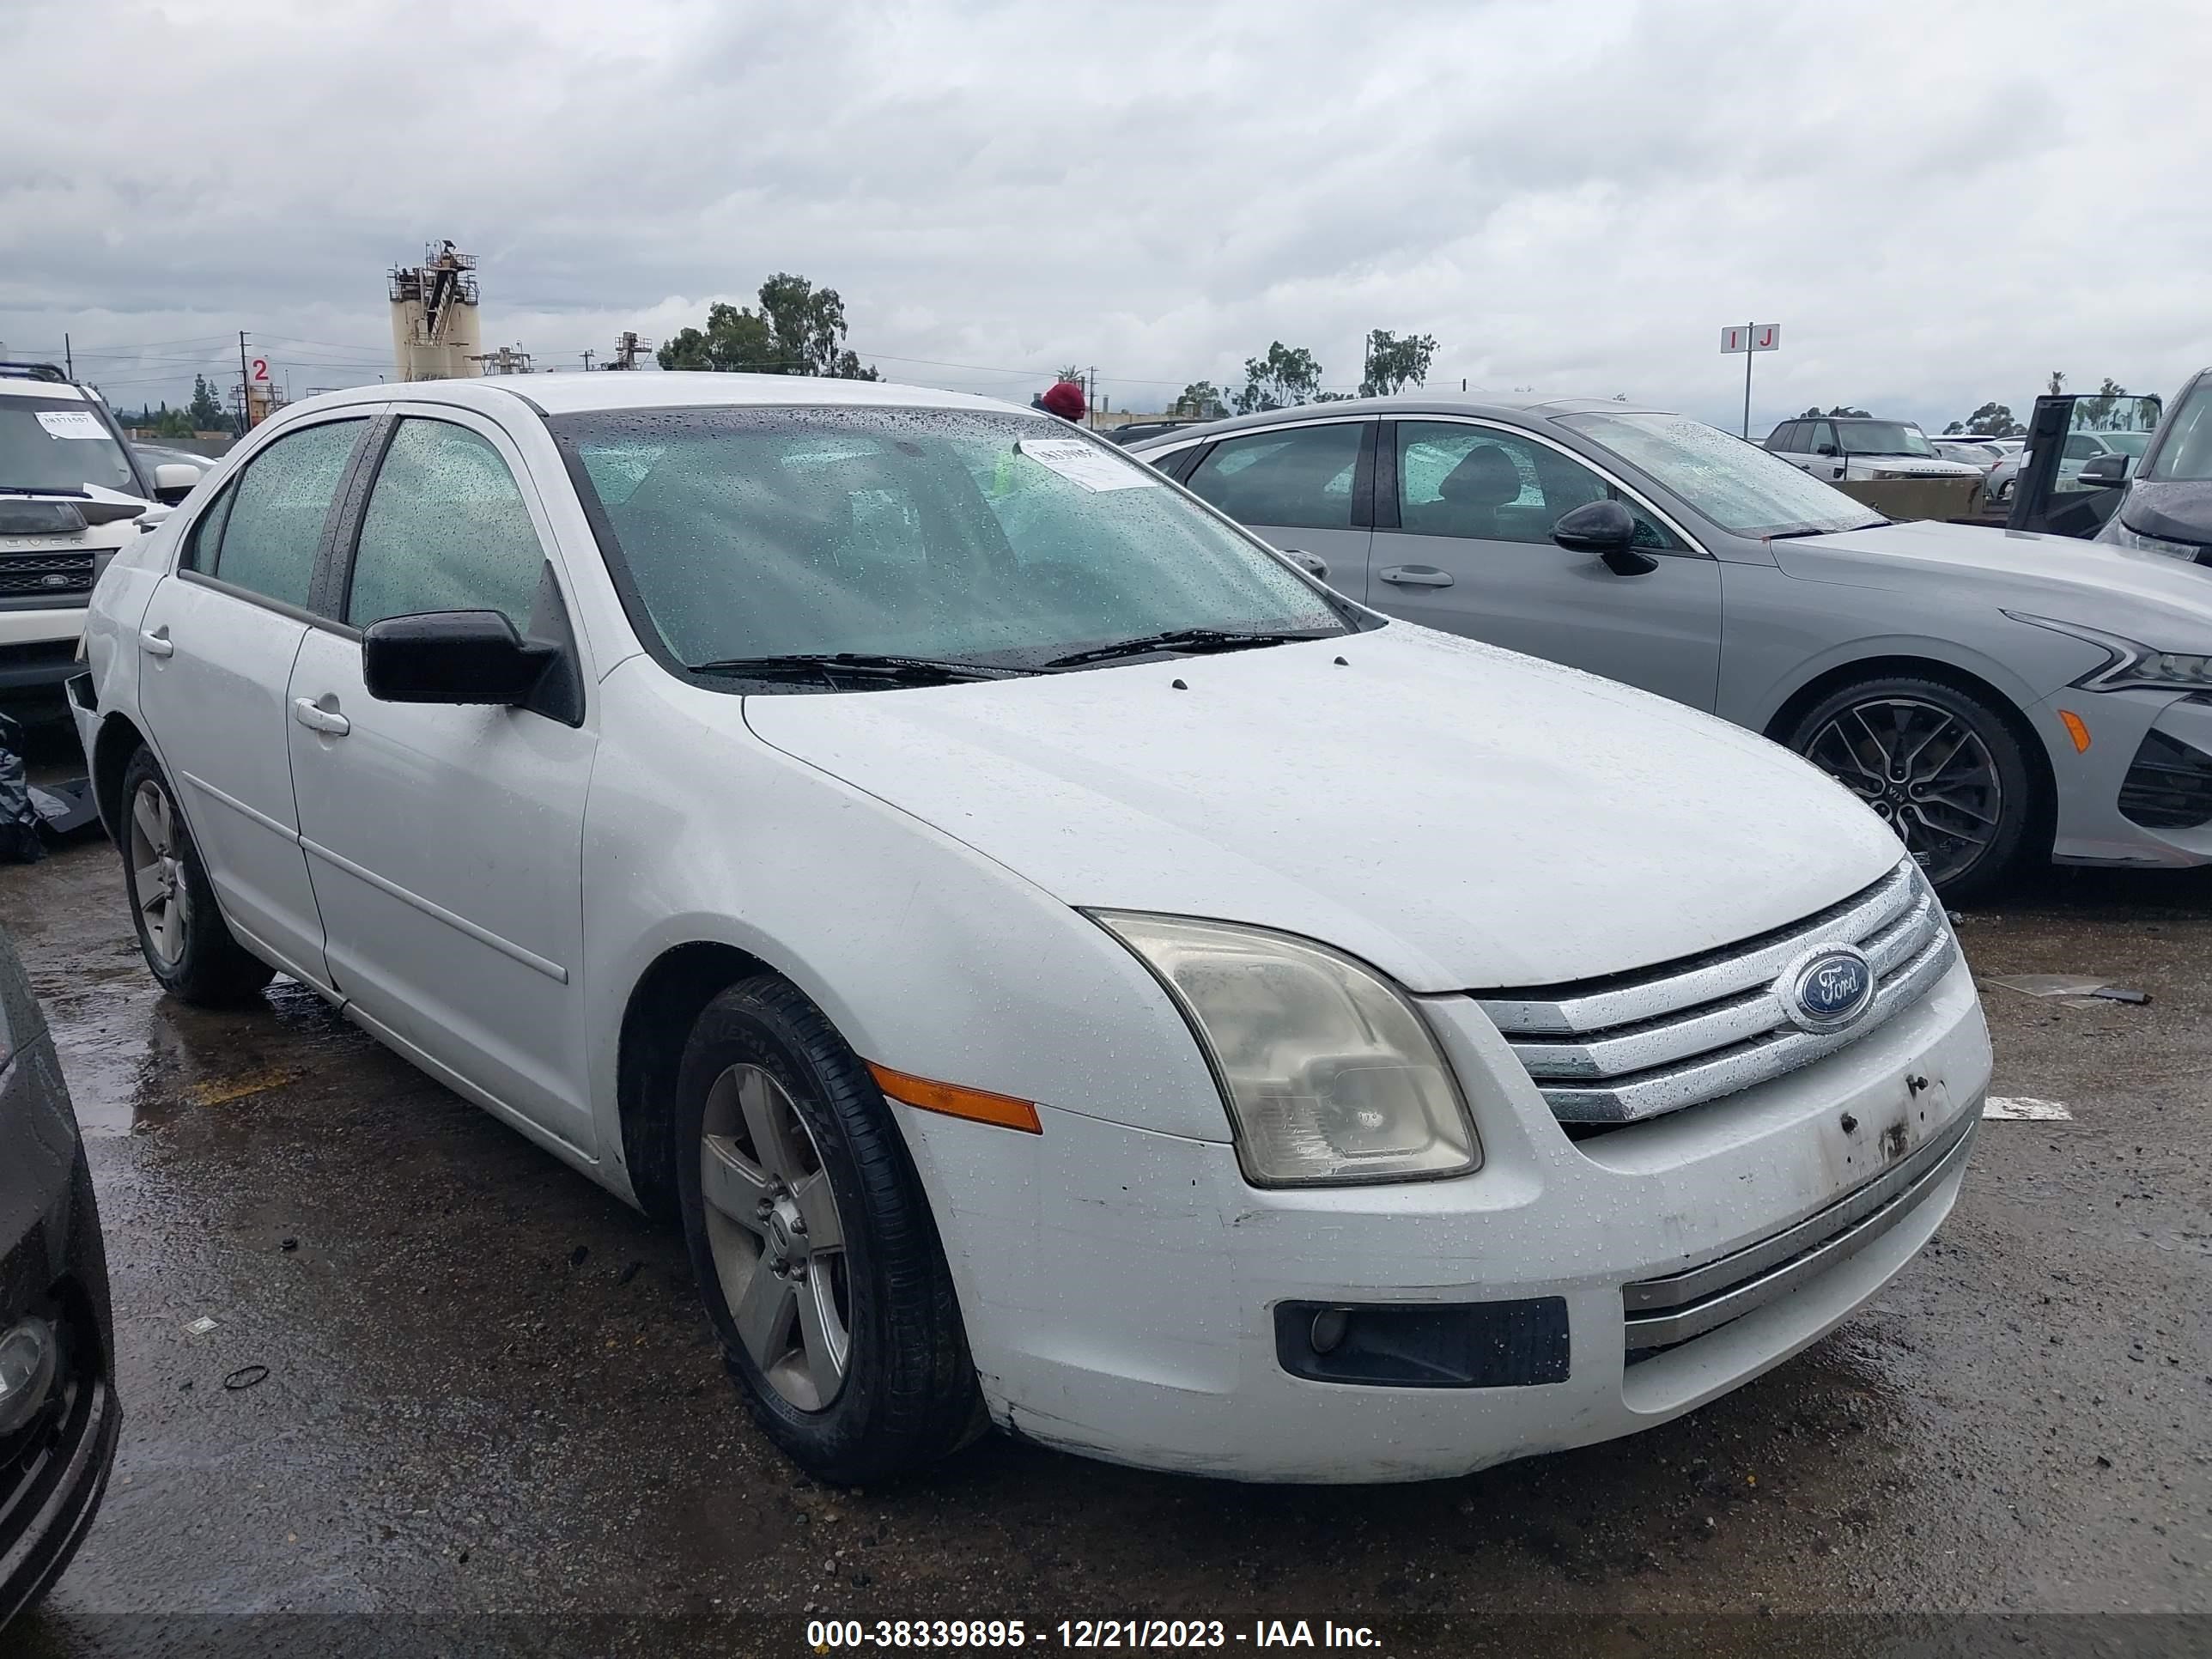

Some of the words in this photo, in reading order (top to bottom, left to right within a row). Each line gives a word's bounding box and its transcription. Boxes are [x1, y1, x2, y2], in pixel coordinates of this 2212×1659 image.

[1730, 330, 1737, 349] I
[1759, 328, 1773, 347] J
[252, 359, 269, 380] 2
[1819, 965, 1859, 1006] Ford
